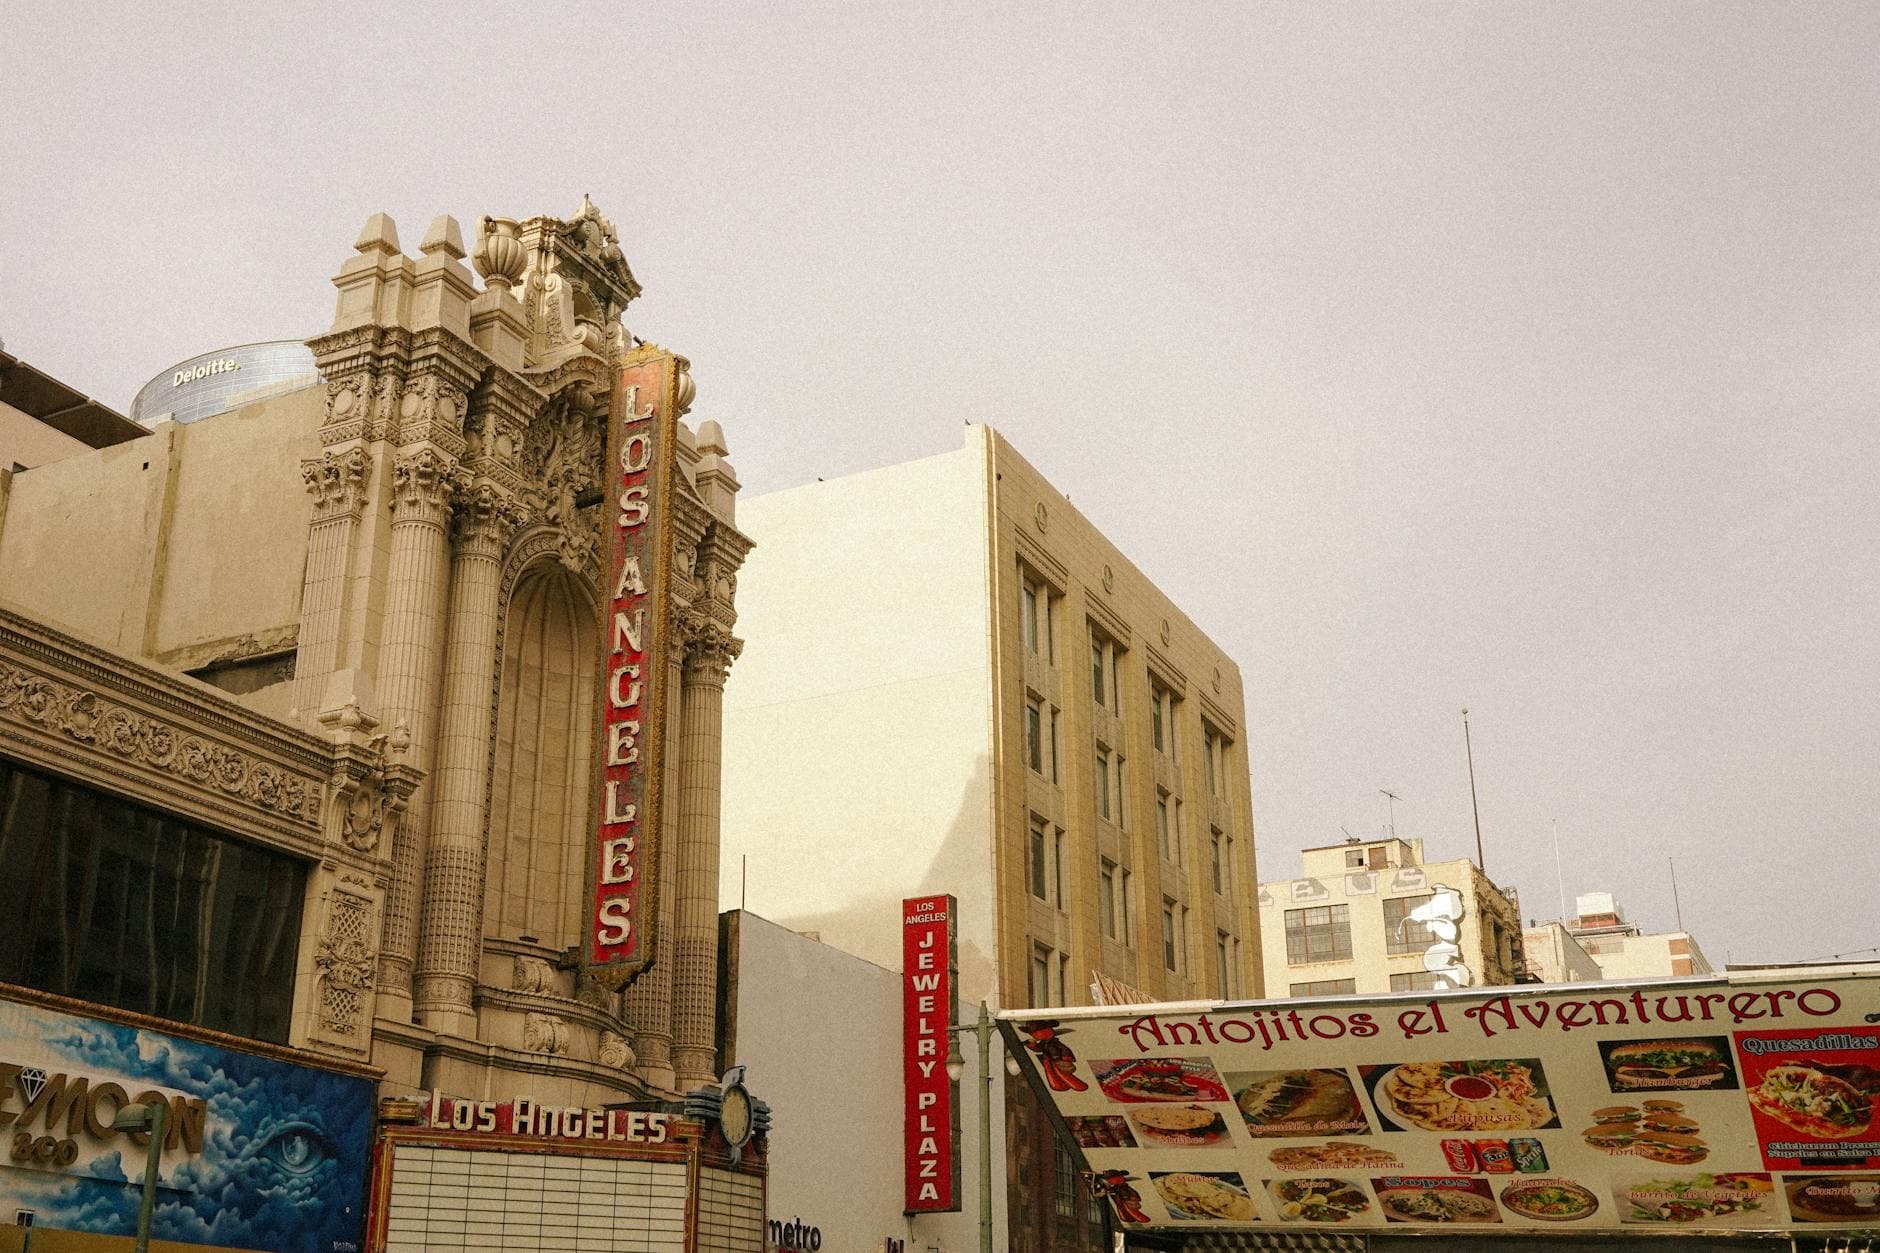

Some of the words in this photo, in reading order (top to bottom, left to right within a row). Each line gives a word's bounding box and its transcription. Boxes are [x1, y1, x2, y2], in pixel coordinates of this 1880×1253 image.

[173, 357, 241, 387] Deloitte.
[619, 384, 654, 528] LOS
[598, 555, 647, 946] ANGELES
[905, 912, 947, 925] ANGELES
[916, 902, 935, 912] LOS
[912, 931, 940, 1078] JEWELRY
[1118, 1009, 1379, 1052] Antojitos
[1398, 1001, 1448, 1039] el
[1464, 988, 1841, 1037] Aventurero
[1742, 1034, 1879, 1055] Quesadillas
[1632, 1078, 1713, 1088] Hamburger
[1447, 1112, 1521, 1126] Pupusas
[917, 1092, 939, 1201] PLAZA
[1384, 1176, 1472, 1189] Sopes
